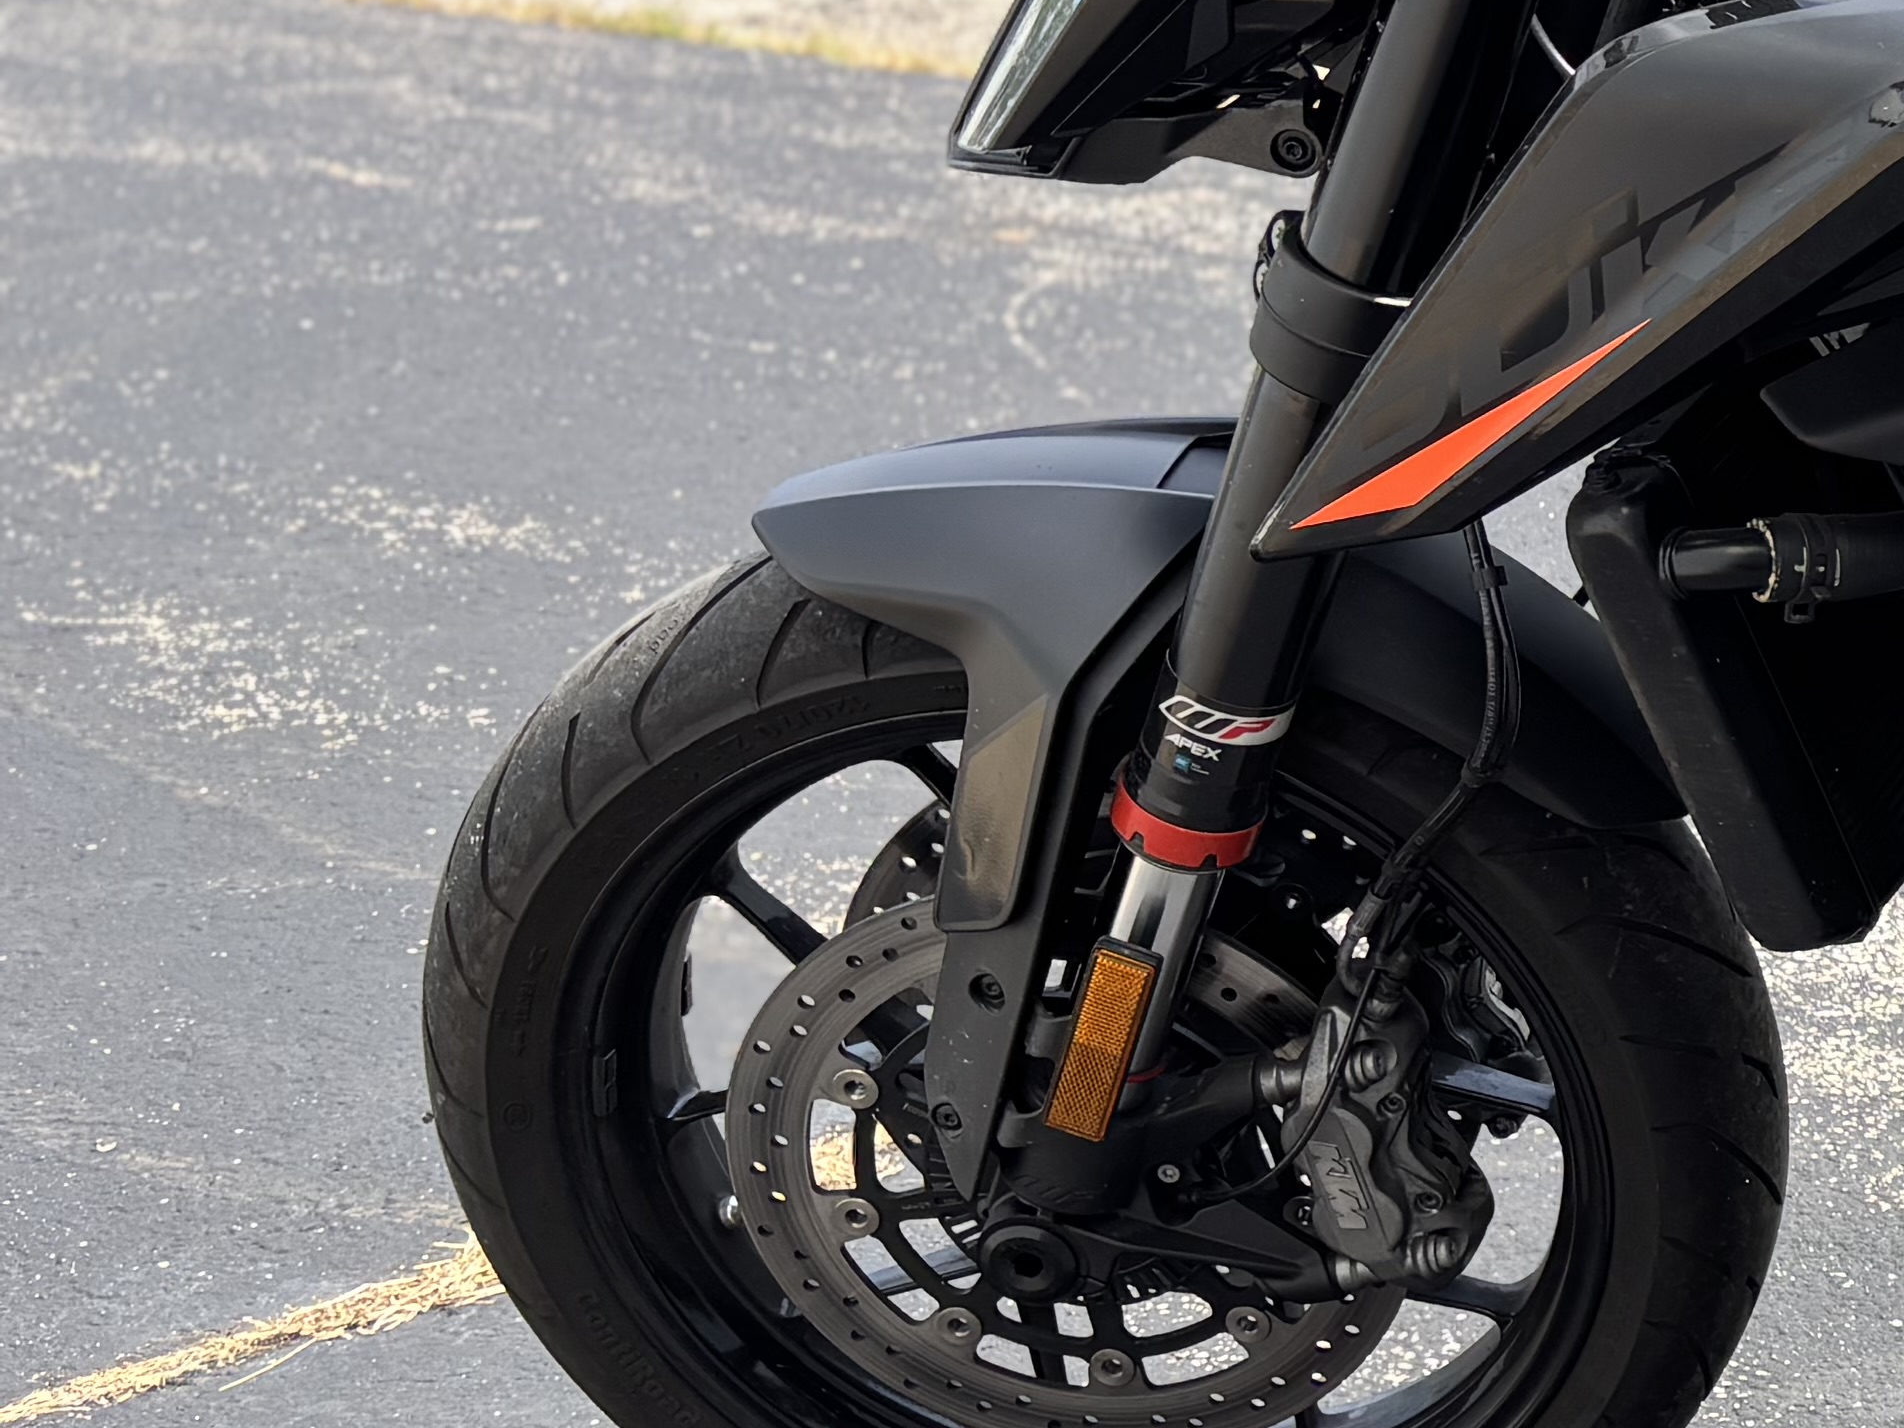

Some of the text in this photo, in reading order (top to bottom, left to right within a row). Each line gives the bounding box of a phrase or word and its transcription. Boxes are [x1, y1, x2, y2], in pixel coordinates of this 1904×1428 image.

[1317, 116, 1855, 500] DUKE
[1163, 733, 1223, 762] APEX
[1307, 1139, 1371, 1230] KTM
